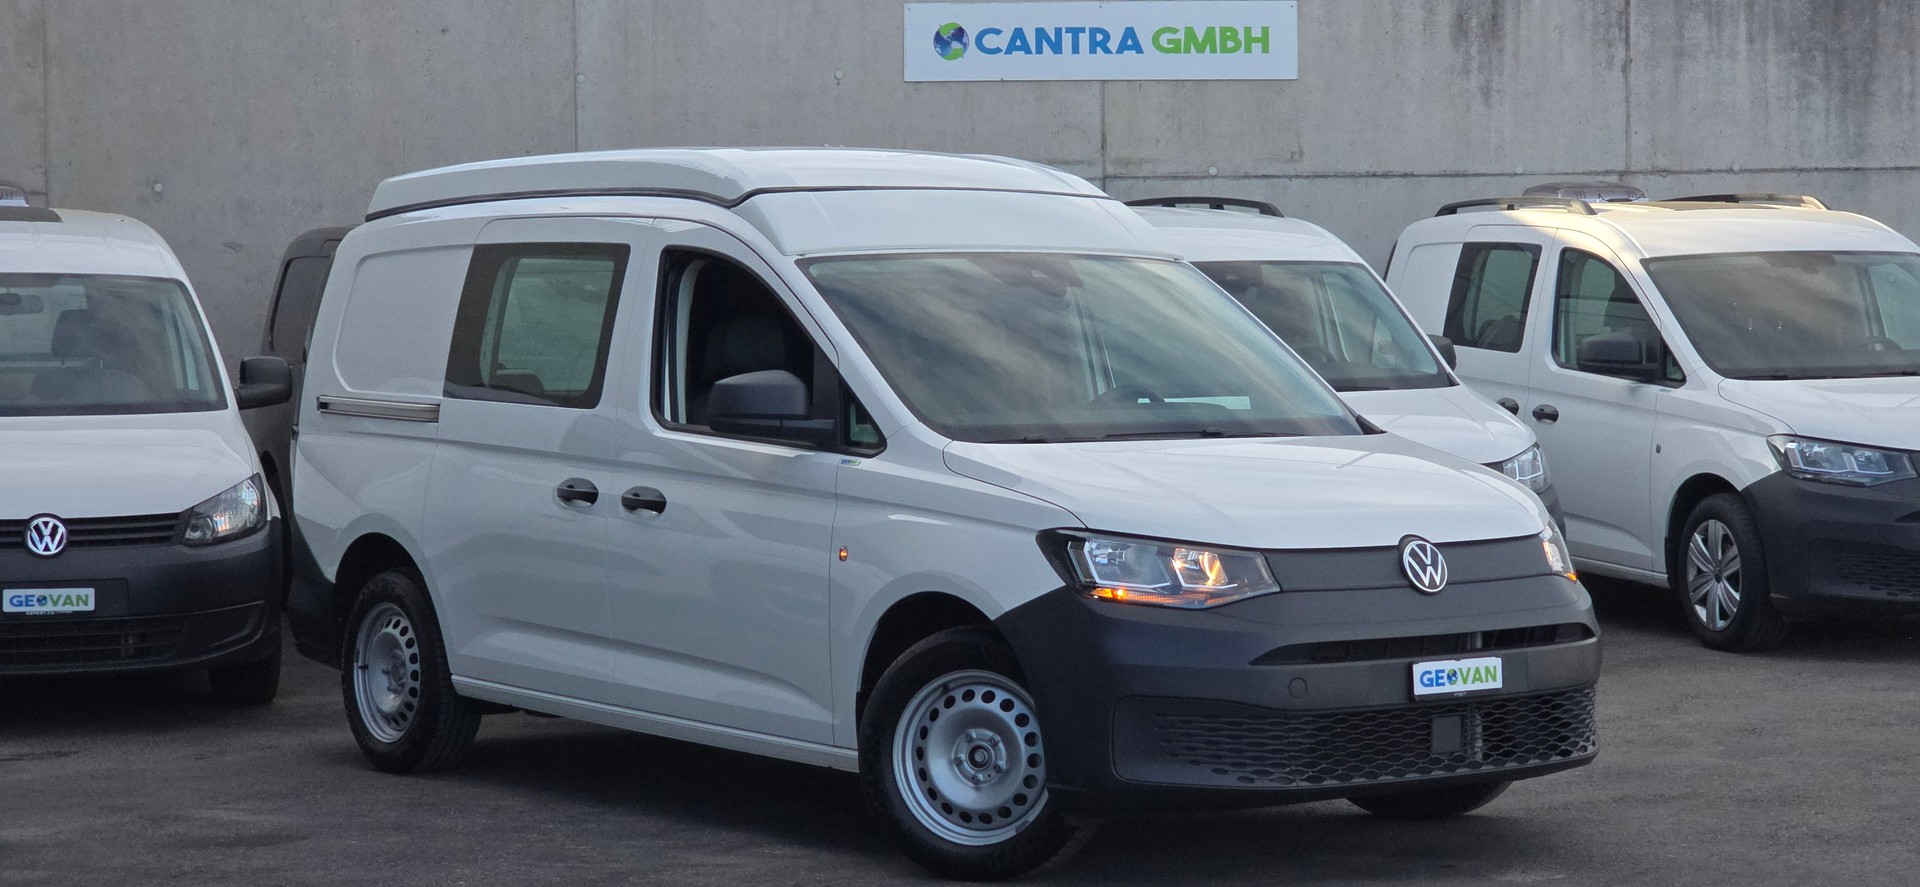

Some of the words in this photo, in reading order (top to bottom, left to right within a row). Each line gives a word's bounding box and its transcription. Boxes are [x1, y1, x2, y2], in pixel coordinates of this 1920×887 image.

[975, 26, 1144, 55] CANTRA
[1151, 26, 1270, 54] GMBH
[28, 517, 66, 555] VW
[1403, 540, 1448, 593] VW
[9, 594, 89, 608] GEOVAN
[1419, 665, 1498, 687] GEOVAN
